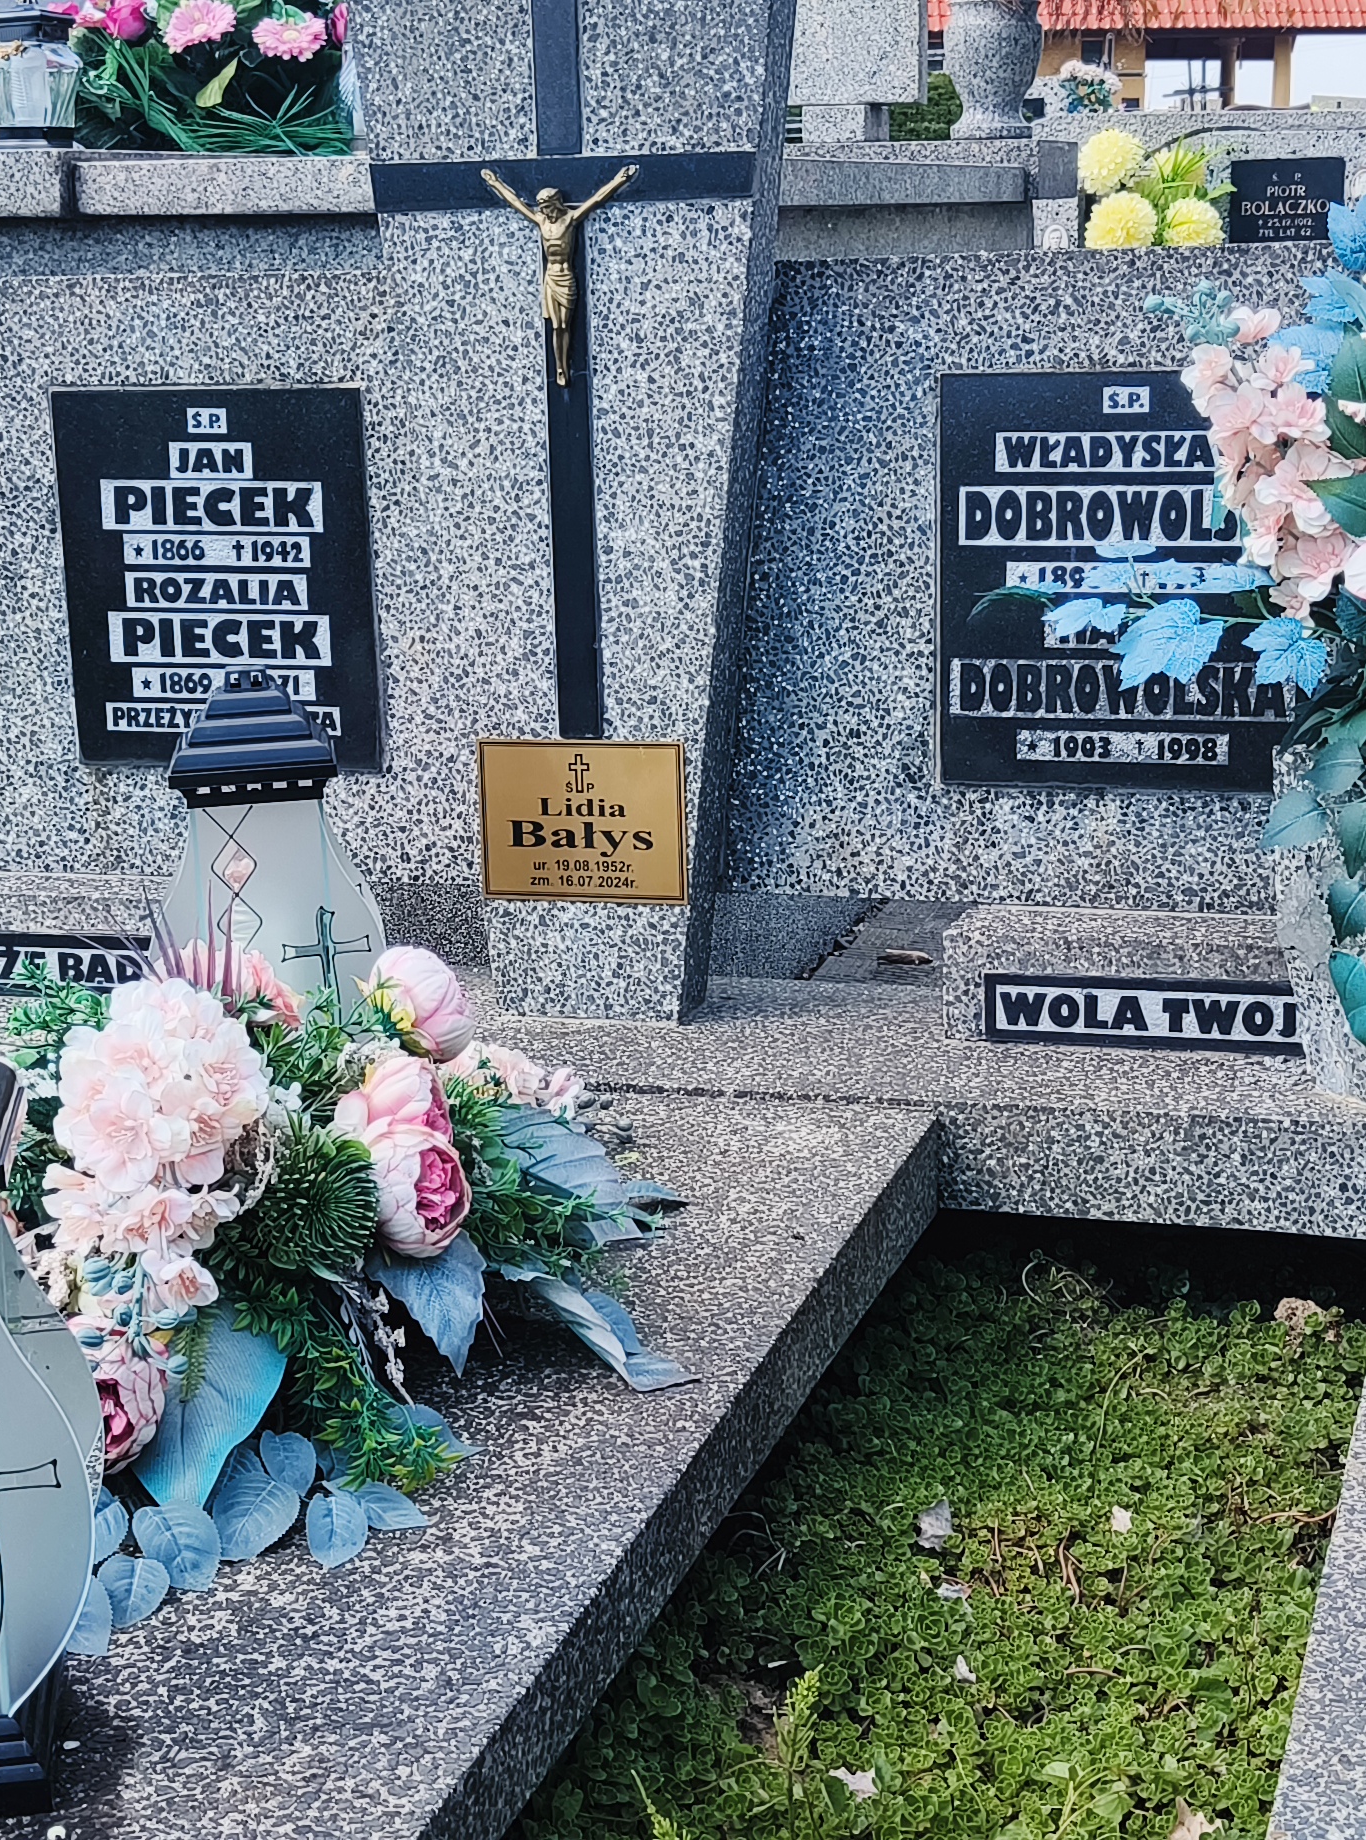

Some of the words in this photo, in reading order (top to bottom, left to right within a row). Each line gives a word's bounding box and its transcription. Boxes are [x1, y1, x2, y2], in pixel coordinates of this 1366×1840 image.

[1266, 185, 1306, 197] PIOTR
[1241, 199, 1329, 216] BOLĄCZKO
[1107, 391, 1145, 409] Ś.P.
[191, 411, 221, 430] Ś.P.
[174, 447, 245, 474] JAN
[113, 485, 315, 528] PIECEK
[151, 538, 205, 561] 1866
[251, 541, 304, 563] 1942
[134, 576, 302, 606] ROZALIA
[121, 617, 322, 660] PIECEK
[159, 671, 212, 695] 1869
[1054, 735, 1112, 759] 1903
[1157, 736, 1218, 761] 1998
[537, 797, 626, 817] Lidia
[506, 819, 654, 858] Bałys
[554, 859, 634, 873] 19.08.1952r.
[558, 874, 639, 889] 16.07.2024r.
[999, 991, 1149, 1031] WOLA
